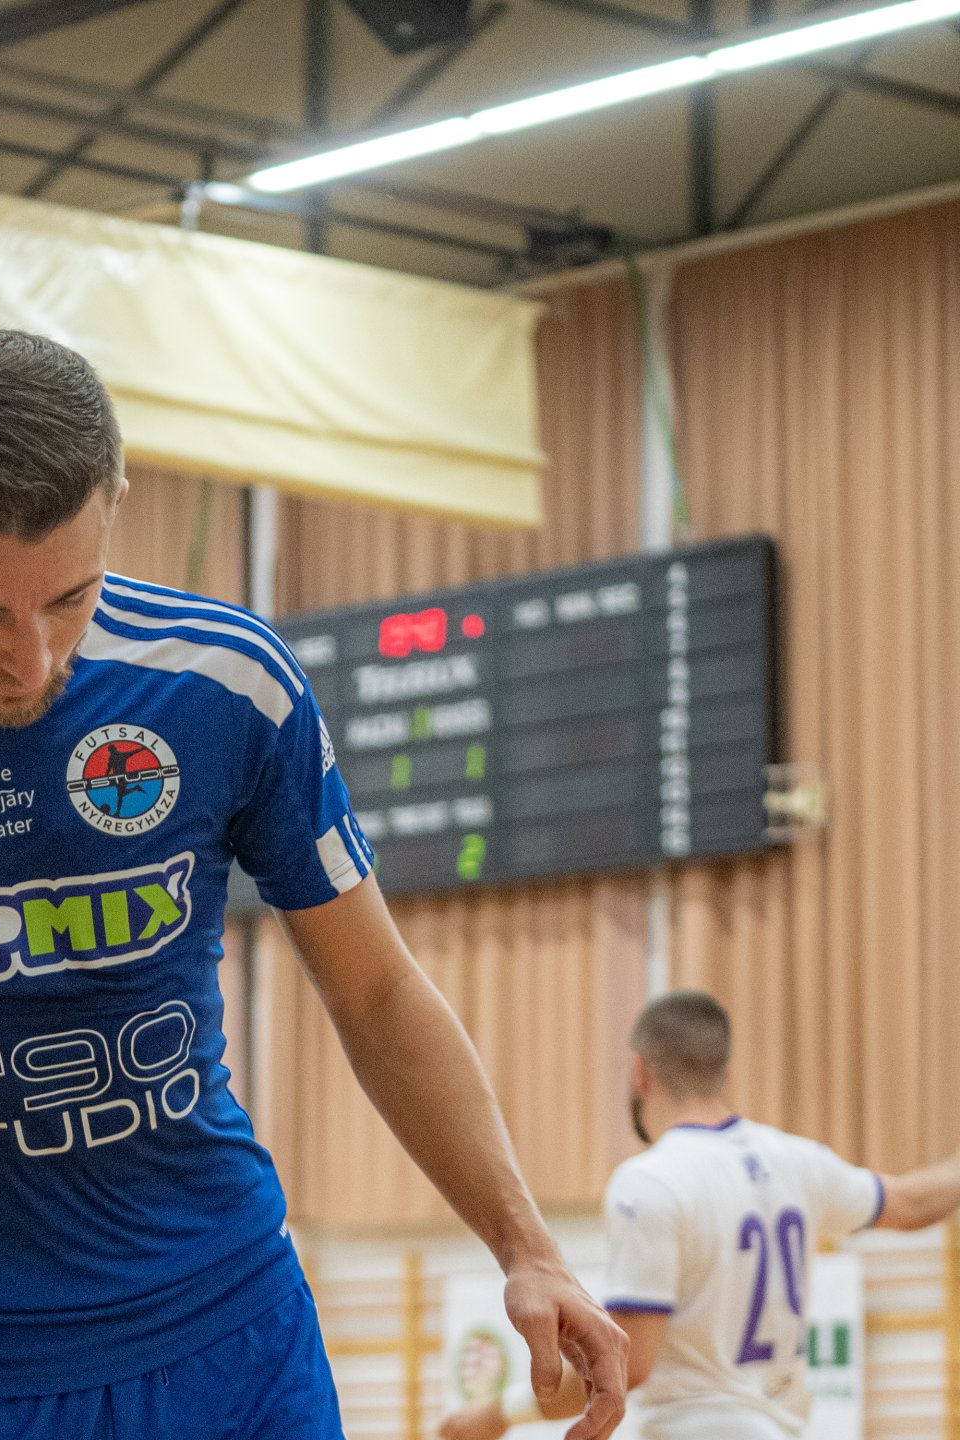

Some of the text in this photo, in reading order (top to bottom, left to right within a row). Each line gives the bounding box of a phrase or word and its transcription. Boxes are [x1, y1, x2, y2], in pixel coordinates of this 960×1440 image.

[75, 727, 159, 762] FUTSAL
[78, 788, 177, 833] NYÍREGYHÁZA
[735, 1206, 807, 1367] 20
